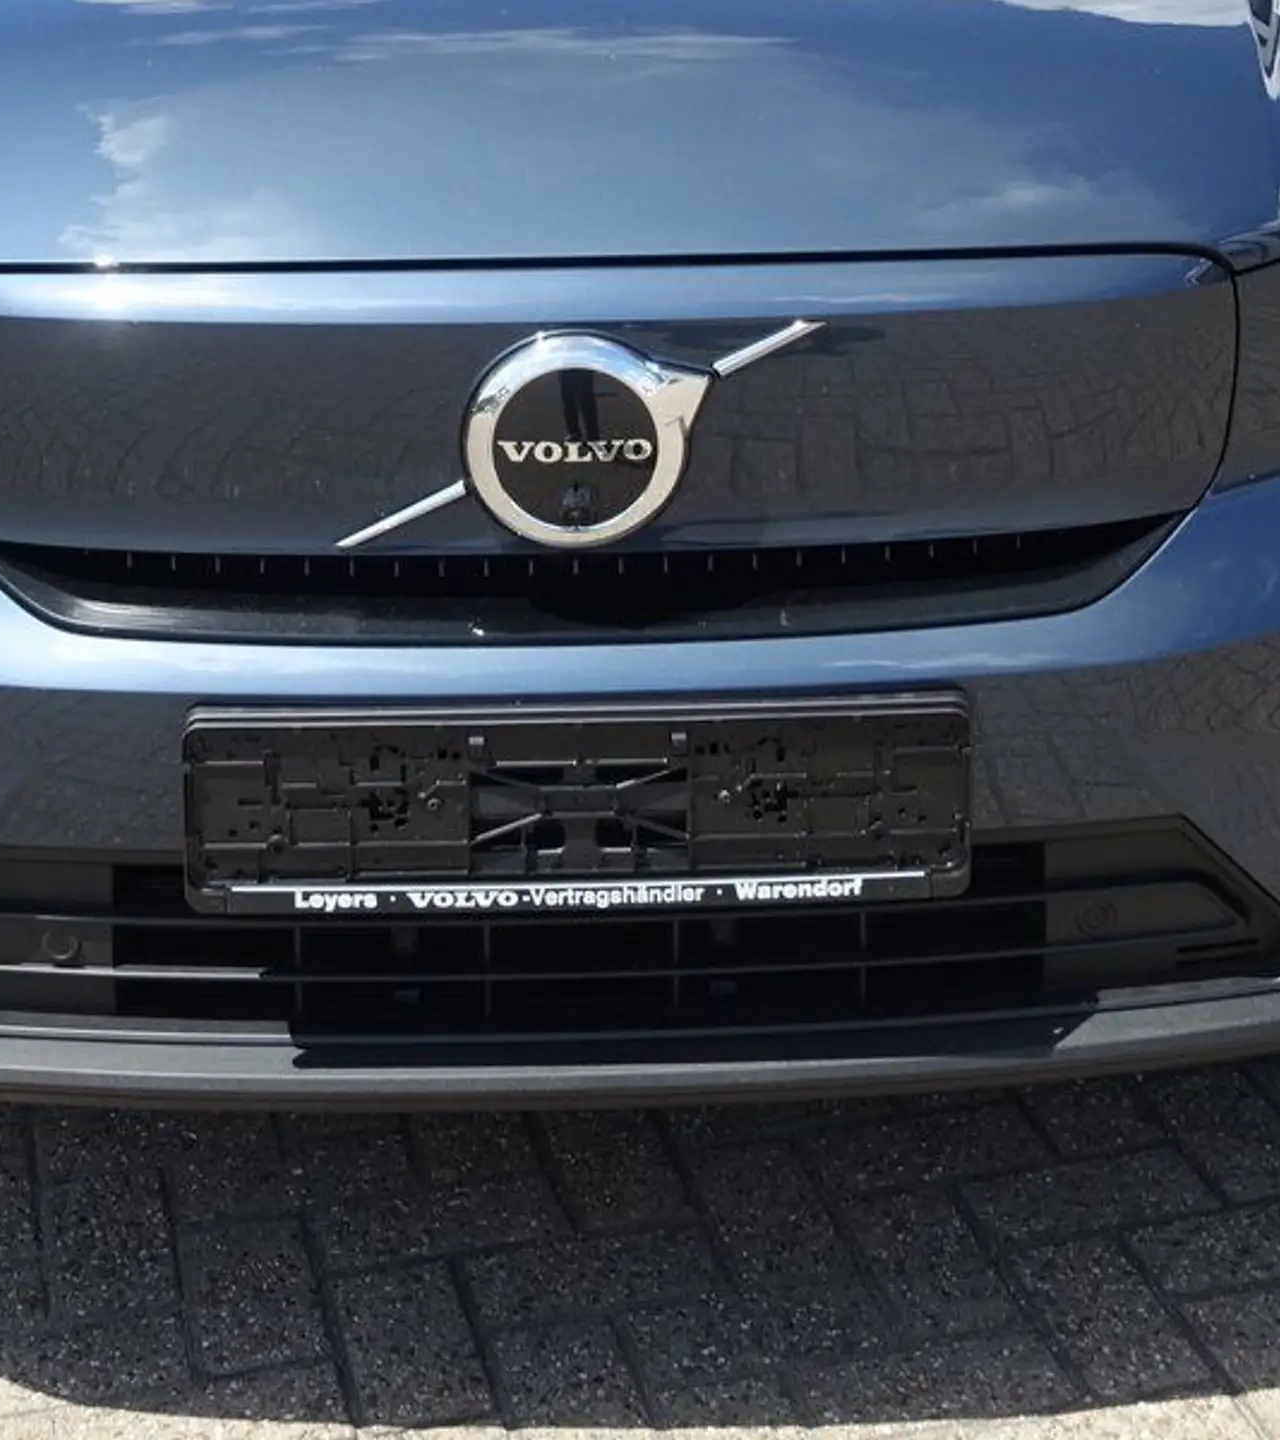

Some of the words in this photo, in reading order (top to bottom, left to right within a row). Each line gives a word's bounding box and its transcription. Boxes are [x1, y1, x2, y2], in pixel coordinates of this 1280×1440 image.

[497, 438, 653, 463] VOLVO
[294, 890, 377, 912] Leyers
[734, 878, 862, 901] Warendorf
